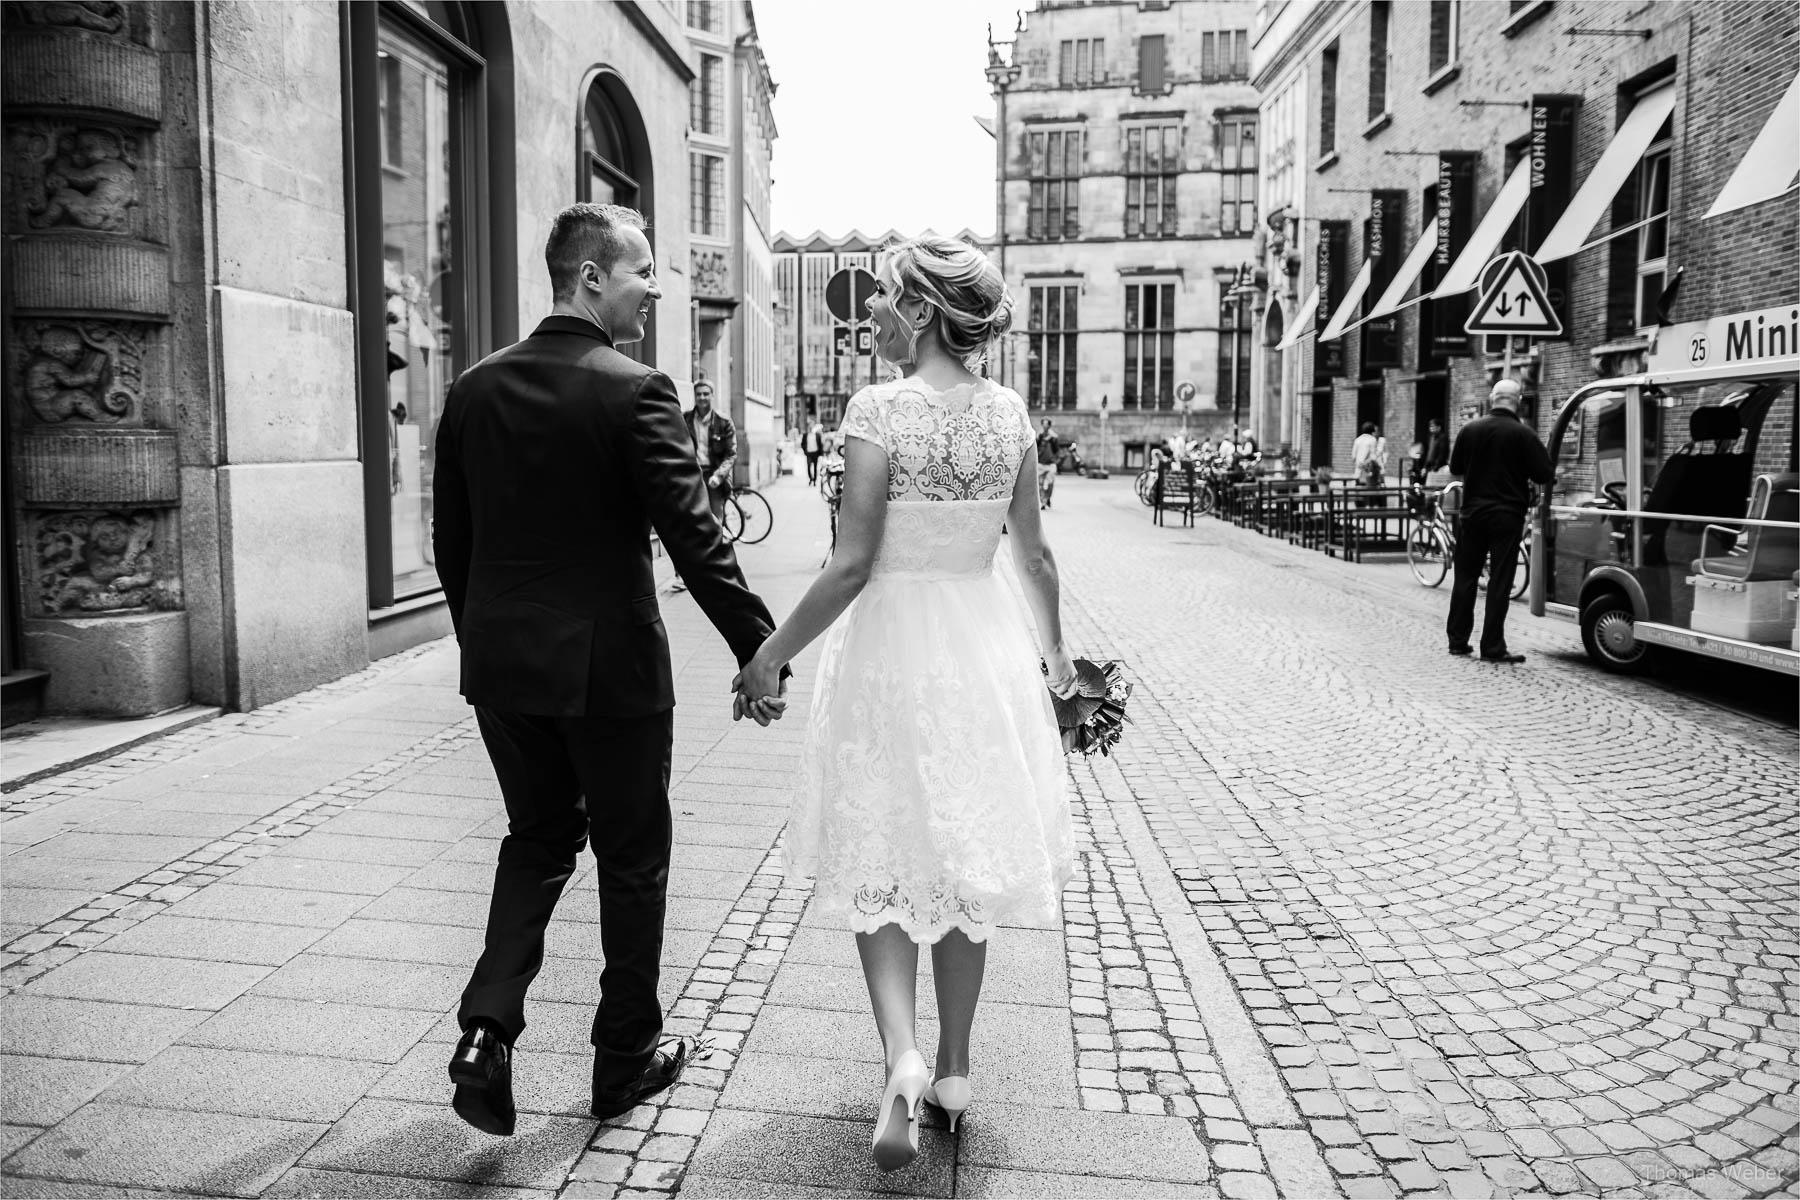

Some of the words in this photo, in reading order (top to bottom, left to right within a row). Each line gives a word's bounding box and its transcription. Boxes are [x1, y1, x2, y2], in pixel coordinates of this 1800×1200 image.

[1532, 107, 1548, 188] WOHNEN
[1370, 199, 1383, 256] FASHION
[1438, 160, 1452, 264] HAIR&BEAUTY
[1691, 338, 1707, 362] 25
[1725, 310, 1798, 362] Mini
[1733, 647, 1747, 659] 800
